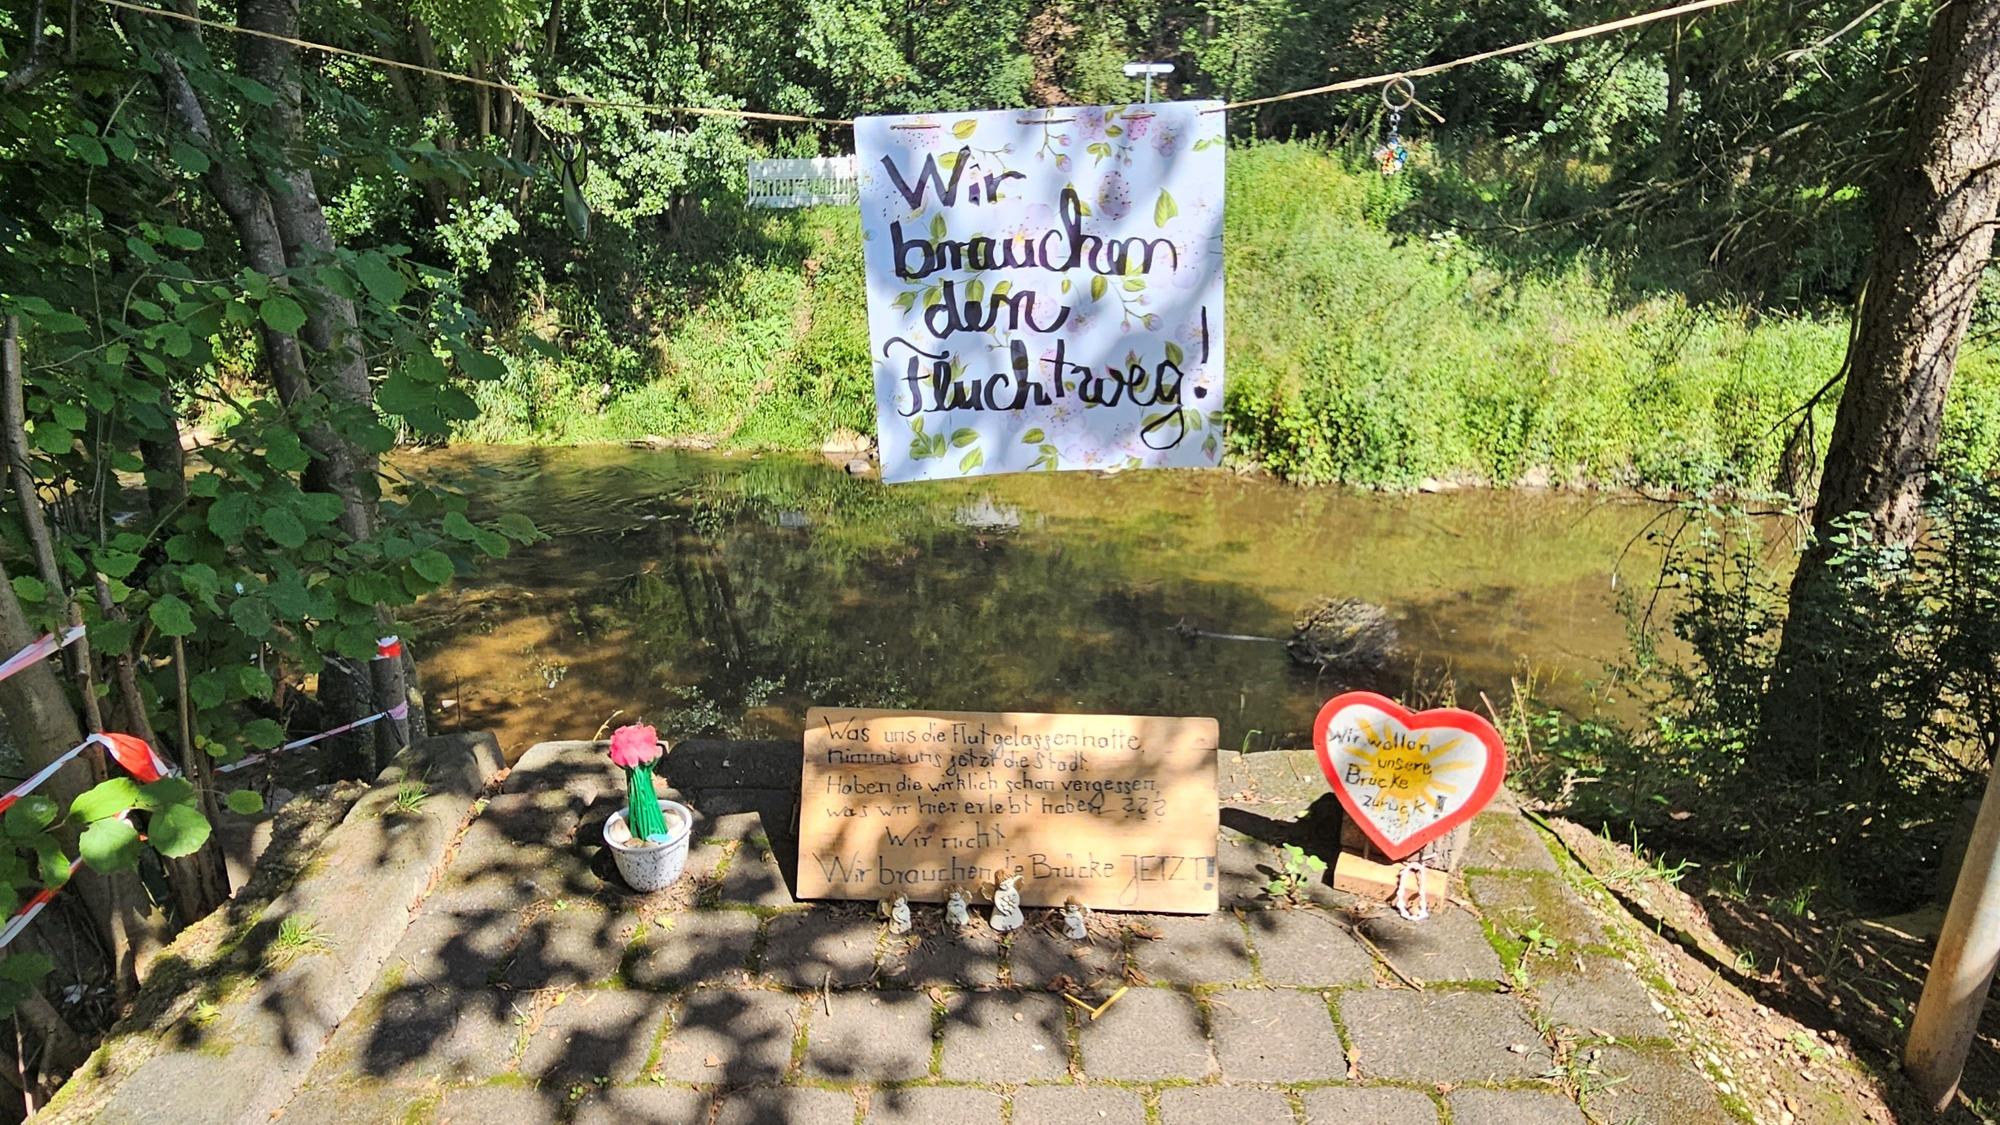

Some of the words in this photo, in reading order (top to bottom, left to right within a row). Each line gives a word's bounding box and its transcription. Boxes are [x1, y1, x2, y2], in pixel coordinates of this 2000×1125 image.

[881, 145, 1027, 210] Wir
[890, 188, 1178, 280] brauchen
[924, 280, 1071, 339] den
[824, 716, 870, 743] Was
[884, 729, 917, 744] uns
[922, 722, 946, 743] die
[951, 722, 990, 745] Flut
[1328, 728, 1360, 744] Wir
[908, 752, 942, 768] uns
[1004, 749, 1029, 768] die
[1378, 757, 1433, 776] unsere
[827, 775, 890, 795] Haben
[896, 774, 923, 792] die
[928, 772, 997, 793] wirklich
[1006, 772, 1055, 793] schon
[827, 805, 867, 818] was
[877, 797, 911, 816] wir
[918, 796, 957, 814] hier
[964, 794, 1032, 815] erlebt
[886, 825, 932, 847] Wir
[942, 821, 1006, 848] nicht
[811, 851, 872, 884] Wir
[879, 856, 992, 886] brauchen
